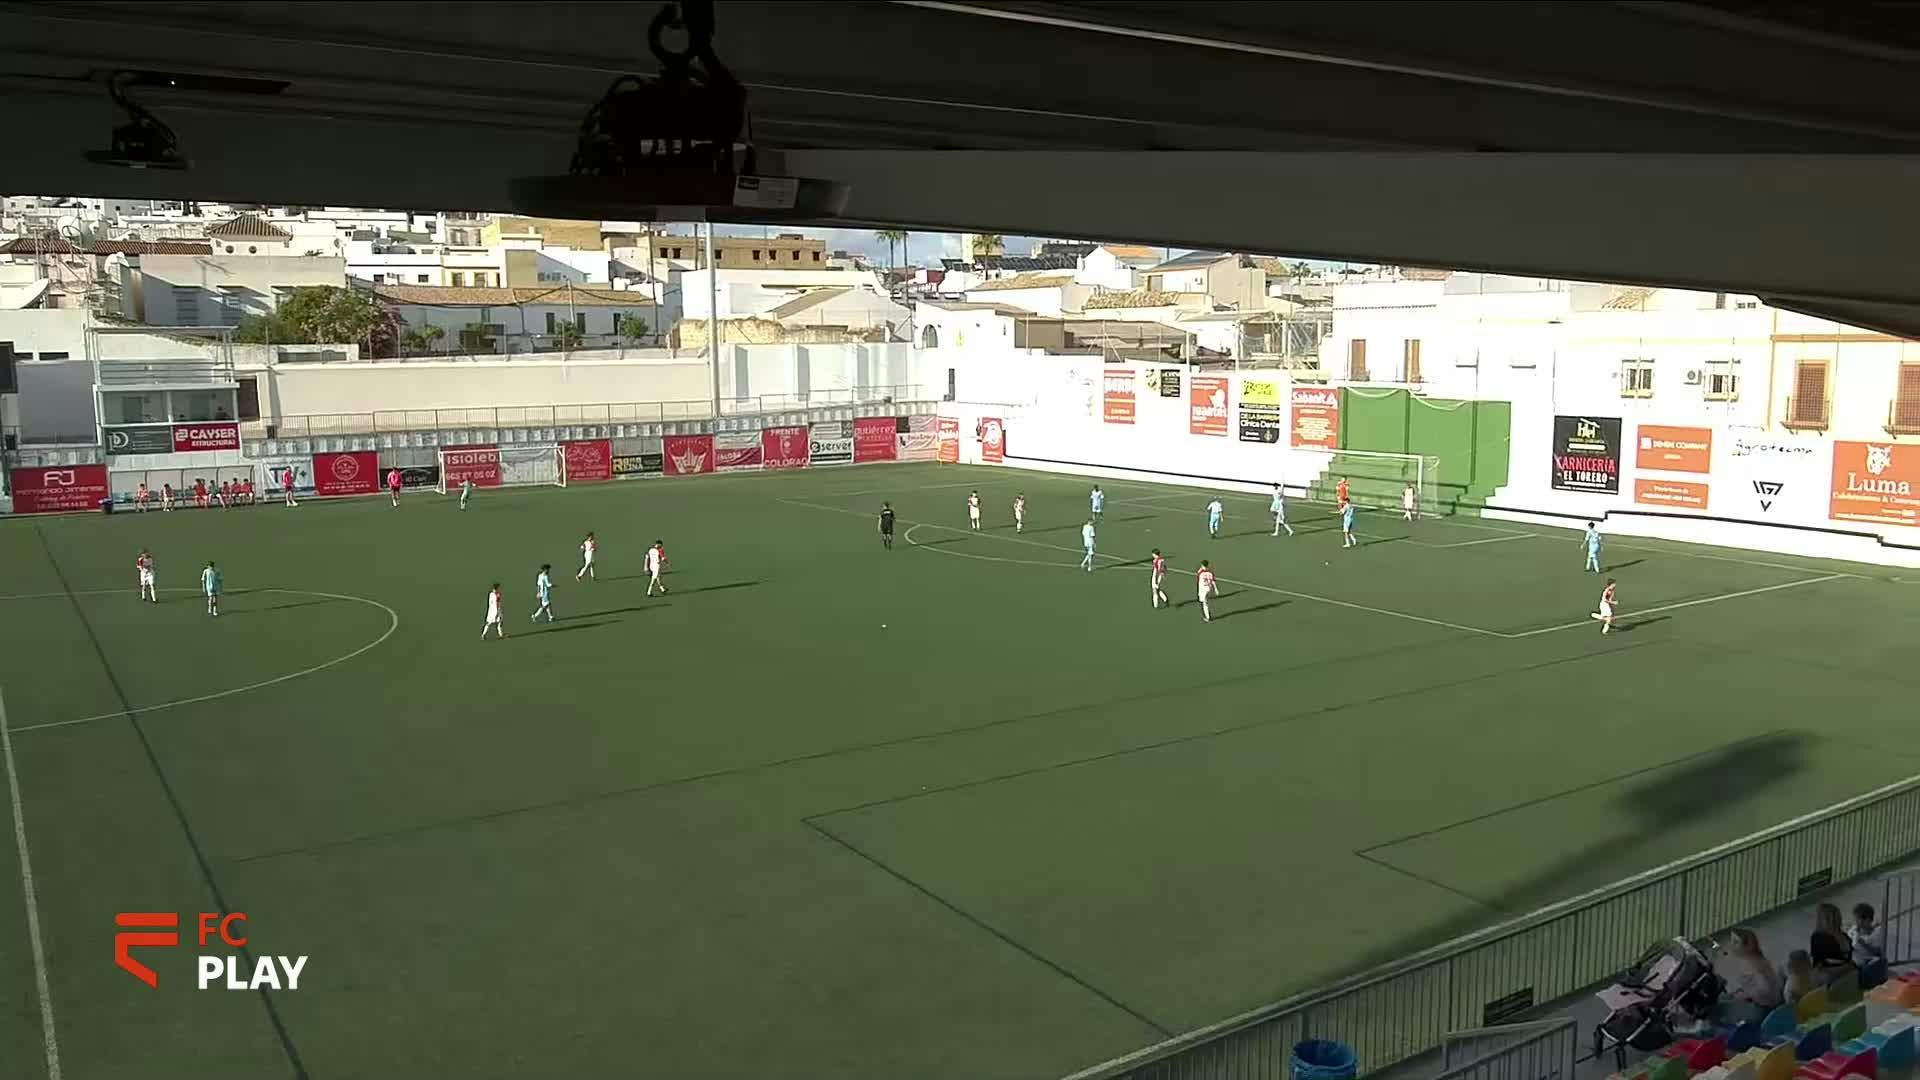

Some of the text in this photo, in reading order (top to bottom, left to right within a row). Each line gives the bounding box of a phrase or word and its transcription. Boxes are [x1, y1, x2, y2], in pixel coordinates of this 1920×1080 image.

[190, 428, 236, 439] CAYSER
[1563, 470, 1608, 483] EL TORERO
[1847, 472, 1911, 495] Luma
